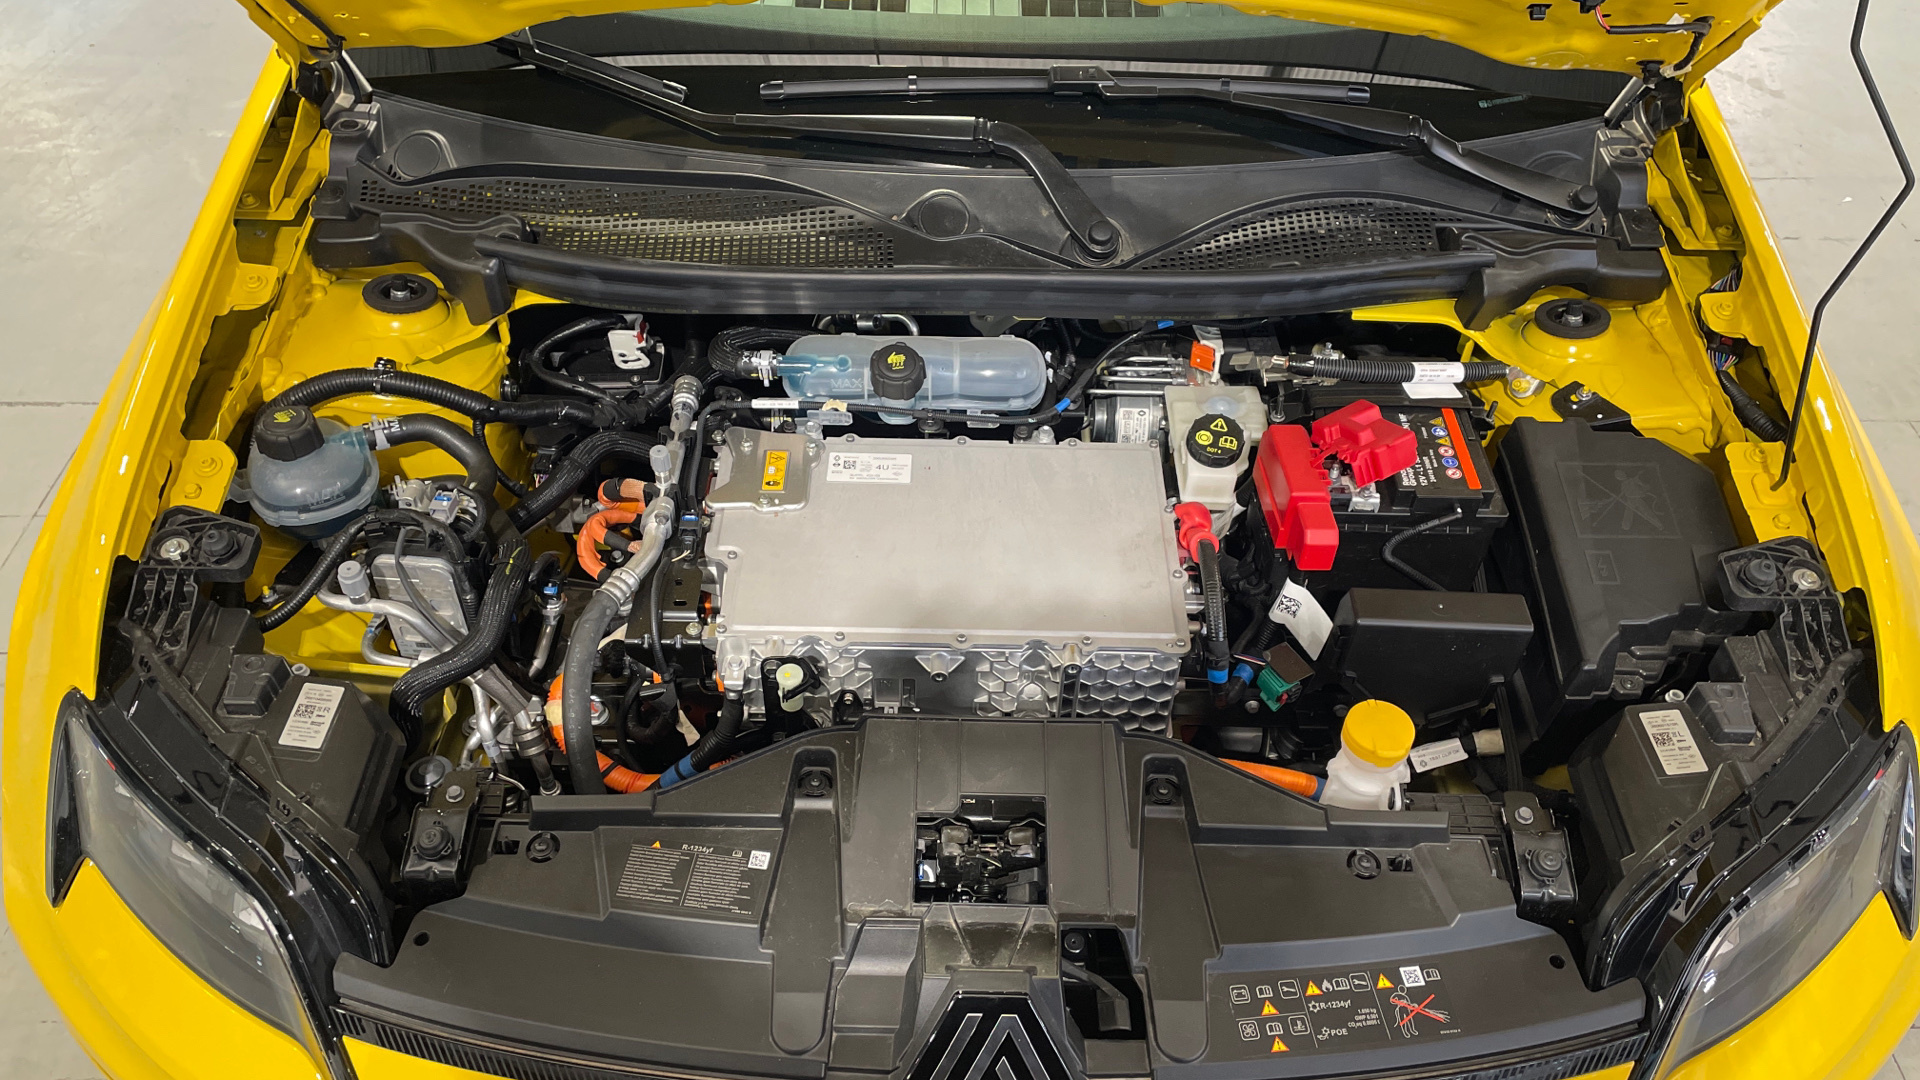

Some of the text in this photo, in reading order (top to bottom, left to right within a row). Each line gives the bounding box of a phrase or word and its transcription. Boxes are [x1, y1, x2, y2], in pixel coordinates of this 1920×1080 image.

[830, 378, 863, 389] MAX
[1406, 467, 1418, 486] Group
[1418, 475, 1429, 486] 12V
[1677, 730, 1685, 738] L
[682, 844, 714, 853] R-1234yf
[1320, 999, 1351, 1009] R-1234yf
[1331, 1028, 1348, 1036] POE
